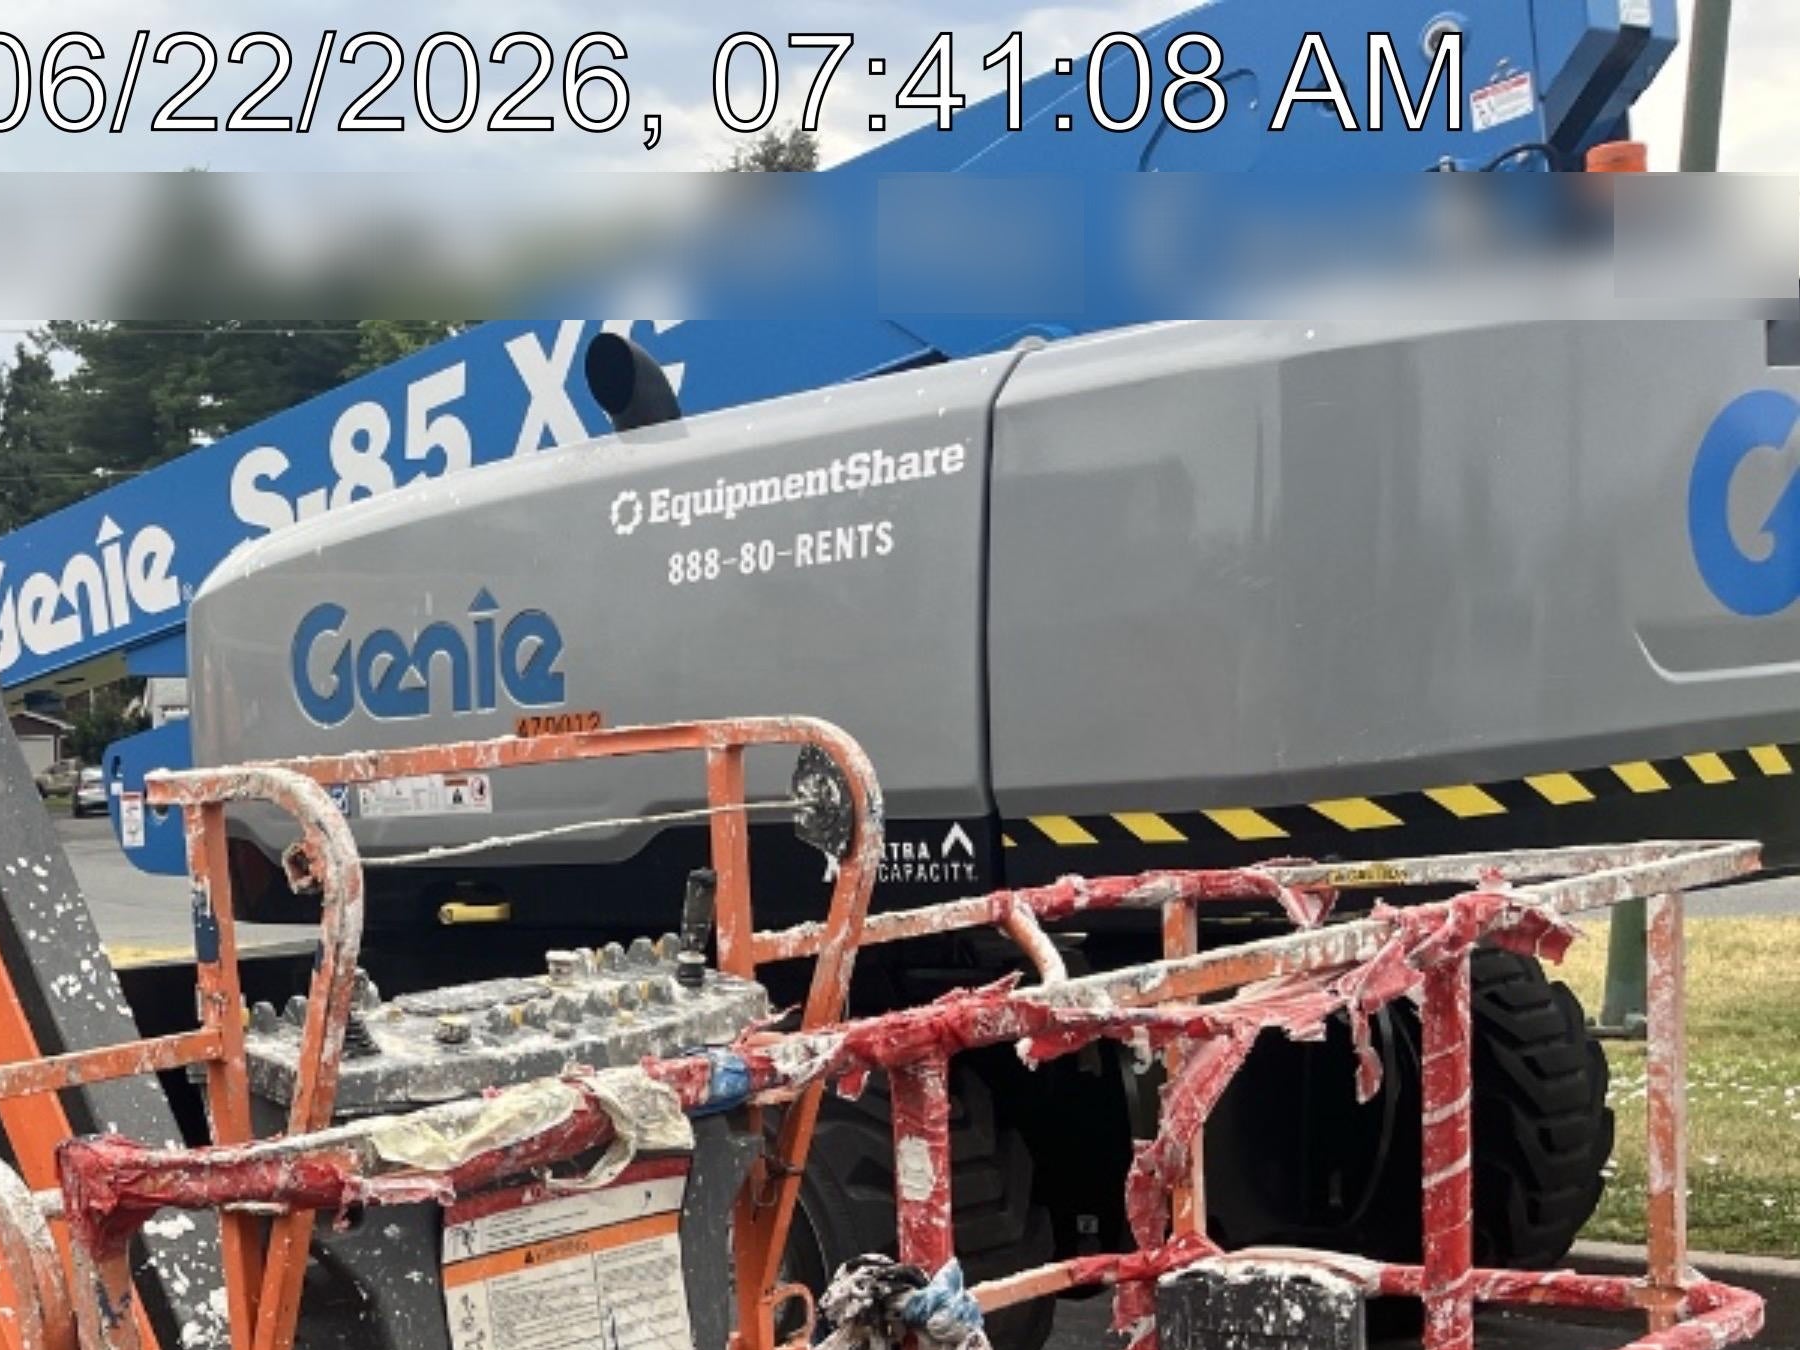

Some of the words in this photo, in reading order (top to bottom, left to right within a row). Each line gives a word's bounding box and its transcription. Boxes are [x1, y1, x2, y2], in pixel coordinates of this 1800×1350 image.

[648, 441, 965, 528] EquipmentShare
[668, 521, 895, 585] 888-80-RENTS
[291, 587, 566, 728] Genie
[878, 863, 976, 883] CAPACITY
